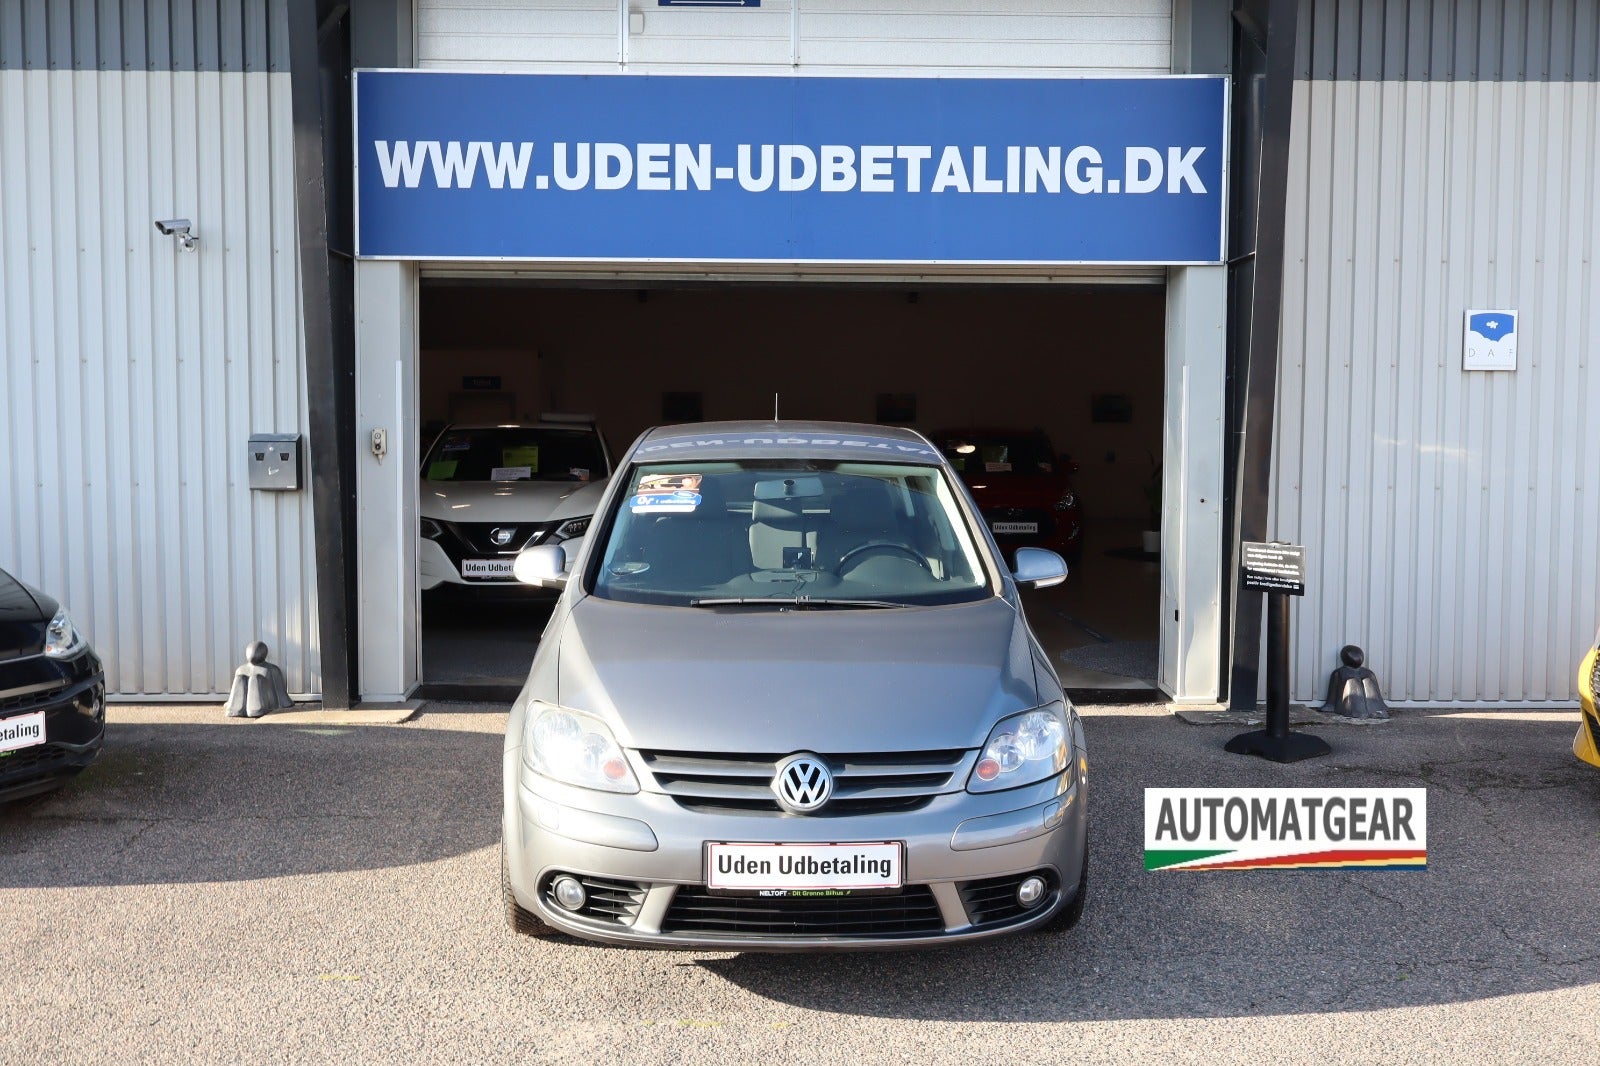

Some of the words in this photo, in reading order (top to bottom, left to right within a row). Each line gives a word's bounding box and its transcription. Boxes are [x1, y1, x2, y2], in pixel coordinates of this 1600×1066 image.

[374, 140, 1208, 194] WWW.UDEN-UDBETALING.DK
[465, 563, 486, 572] Uden
[488, 563, 514, 572] Udbet
[718, 854, 771, 875] Uden
[779, 854, 892, 878] Udbetaling
